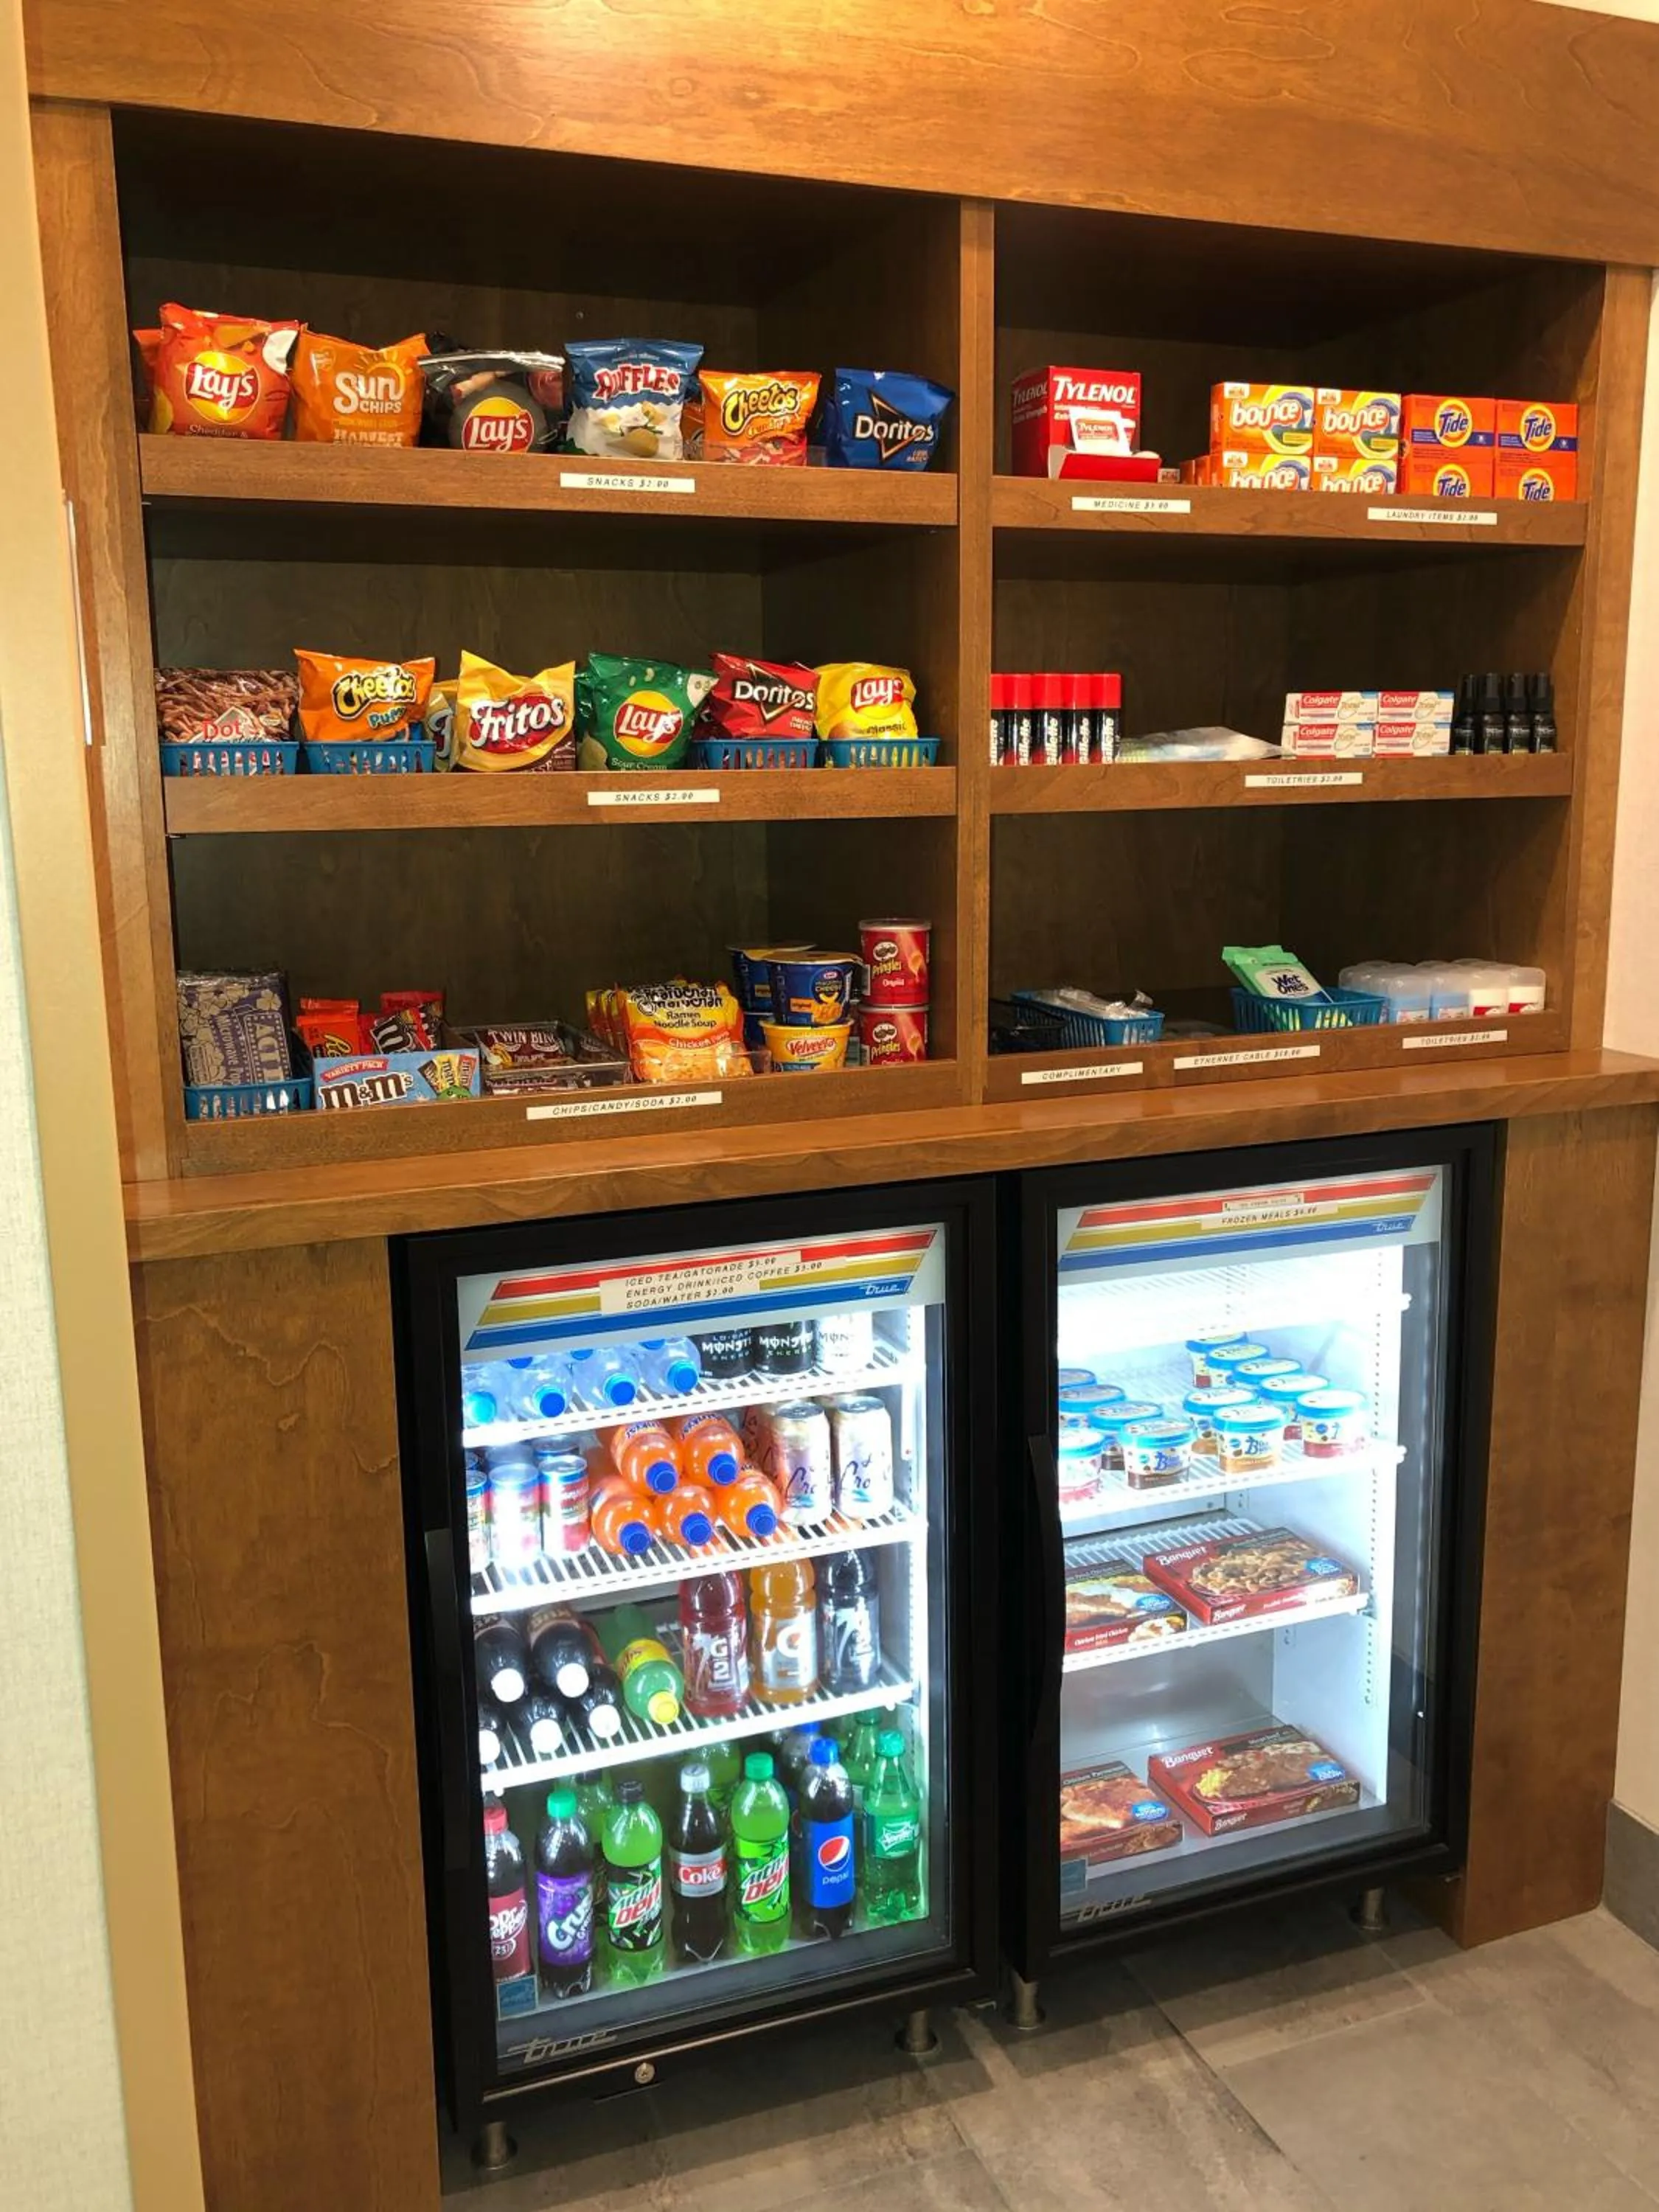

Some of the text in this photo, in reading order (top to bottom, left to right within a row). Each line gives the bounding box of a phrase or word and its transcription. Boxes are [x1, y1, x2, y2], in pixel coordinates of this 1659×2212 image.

[188, 364, 255, 410] Lay's
[333, 371, 404, 414] Sun
[592, 364, 682, 401] RUFFLES
[1053, 375, 1137, 404] TYLENOL
[359, 400, 403, 414] CHIPS
[722, 381, 801, 436] Cheetos
[1231, 398, 1300, 428] bounce
[855, 414, 935, 443] Doritos
[1323, 406, 1386, 434] bounce
[1438, 411, 1469, 437] Tide
[1523, 416, 1552, 442] Tide
[469, 413, 529, 452] Lay's
[586, 476, 635, 487] SNACKS
[1436, 477, 1467, 497] Tide
[1522, 480, 1551, 501] Tide
[1093, 500, 1141, 509] MEDICINE
[1385, 510, 1425, 520] LAUNDRY
[1427, 512, 1454, 521] ITEMS
[331, 665, 416, 720] Cheetos
[734, 680, 815, 711] Doritos
[1303, 695, 1340, 706] Colgate
[1382, 695, 1417, 706] Colgate
[470, 698, 566, 748] Fritos
[619, 704, 684, 744] Lay's
[1300, 726, 1335, 737] Colgate
[1380, 725, 1415, 735] Colgate
[1266, 776, 1318, 785] TOILETRIES
[614, 793, 661, 802] SNACKS
[872, 960, 901, 978] Pringles
[1270, 973, 1301, 986] Wet
[1276, 981, 1309, 995] Ones
[653, 1019, 717, 1029] Noodle Soup
[666, 1011, 701, 1020] Ramen
[487, 1029, 556, 1045] TWIN BIN
[871, 1042, 901, 1059] Pringles
[1194, 1054, 1239, 1065] ETHERNET
[1242, 1051, 1270, 1061] CABLE
[324, 1058, 385, 1078] VARIETY PACK
[1042, 1066, 1121, 1080] COMPLIMENTARY
[319, 1072, 414, 1110] m&m's
[552, 1097, 664, 1116] CHIPS/CANDY/SODA
[1221, 1214, 1258, 1225] FROZEN
[1260, 1210, 1290, 1222] MEALS
[625, 1276, 658, 1287] ICED
[658, 1262, 744, 1282] TEA/GATORADE
[626, 1284, 672, 1298] ENERGY
[747, 1267, 791, 1280] COFFEE
[626, 1293, 701, 1310] SODA/WATER
[1156, 1545, 1207, 1566] Banquet
[1161, 1746, 1214, 1769] Banquet
[1214, 1812, 1248, 1832] Banquet
[679, 1865, 722, 1885] Coke
[822, 1871, 849, 1885] pepsi
[547, 1885, 592, 1951] Crus
